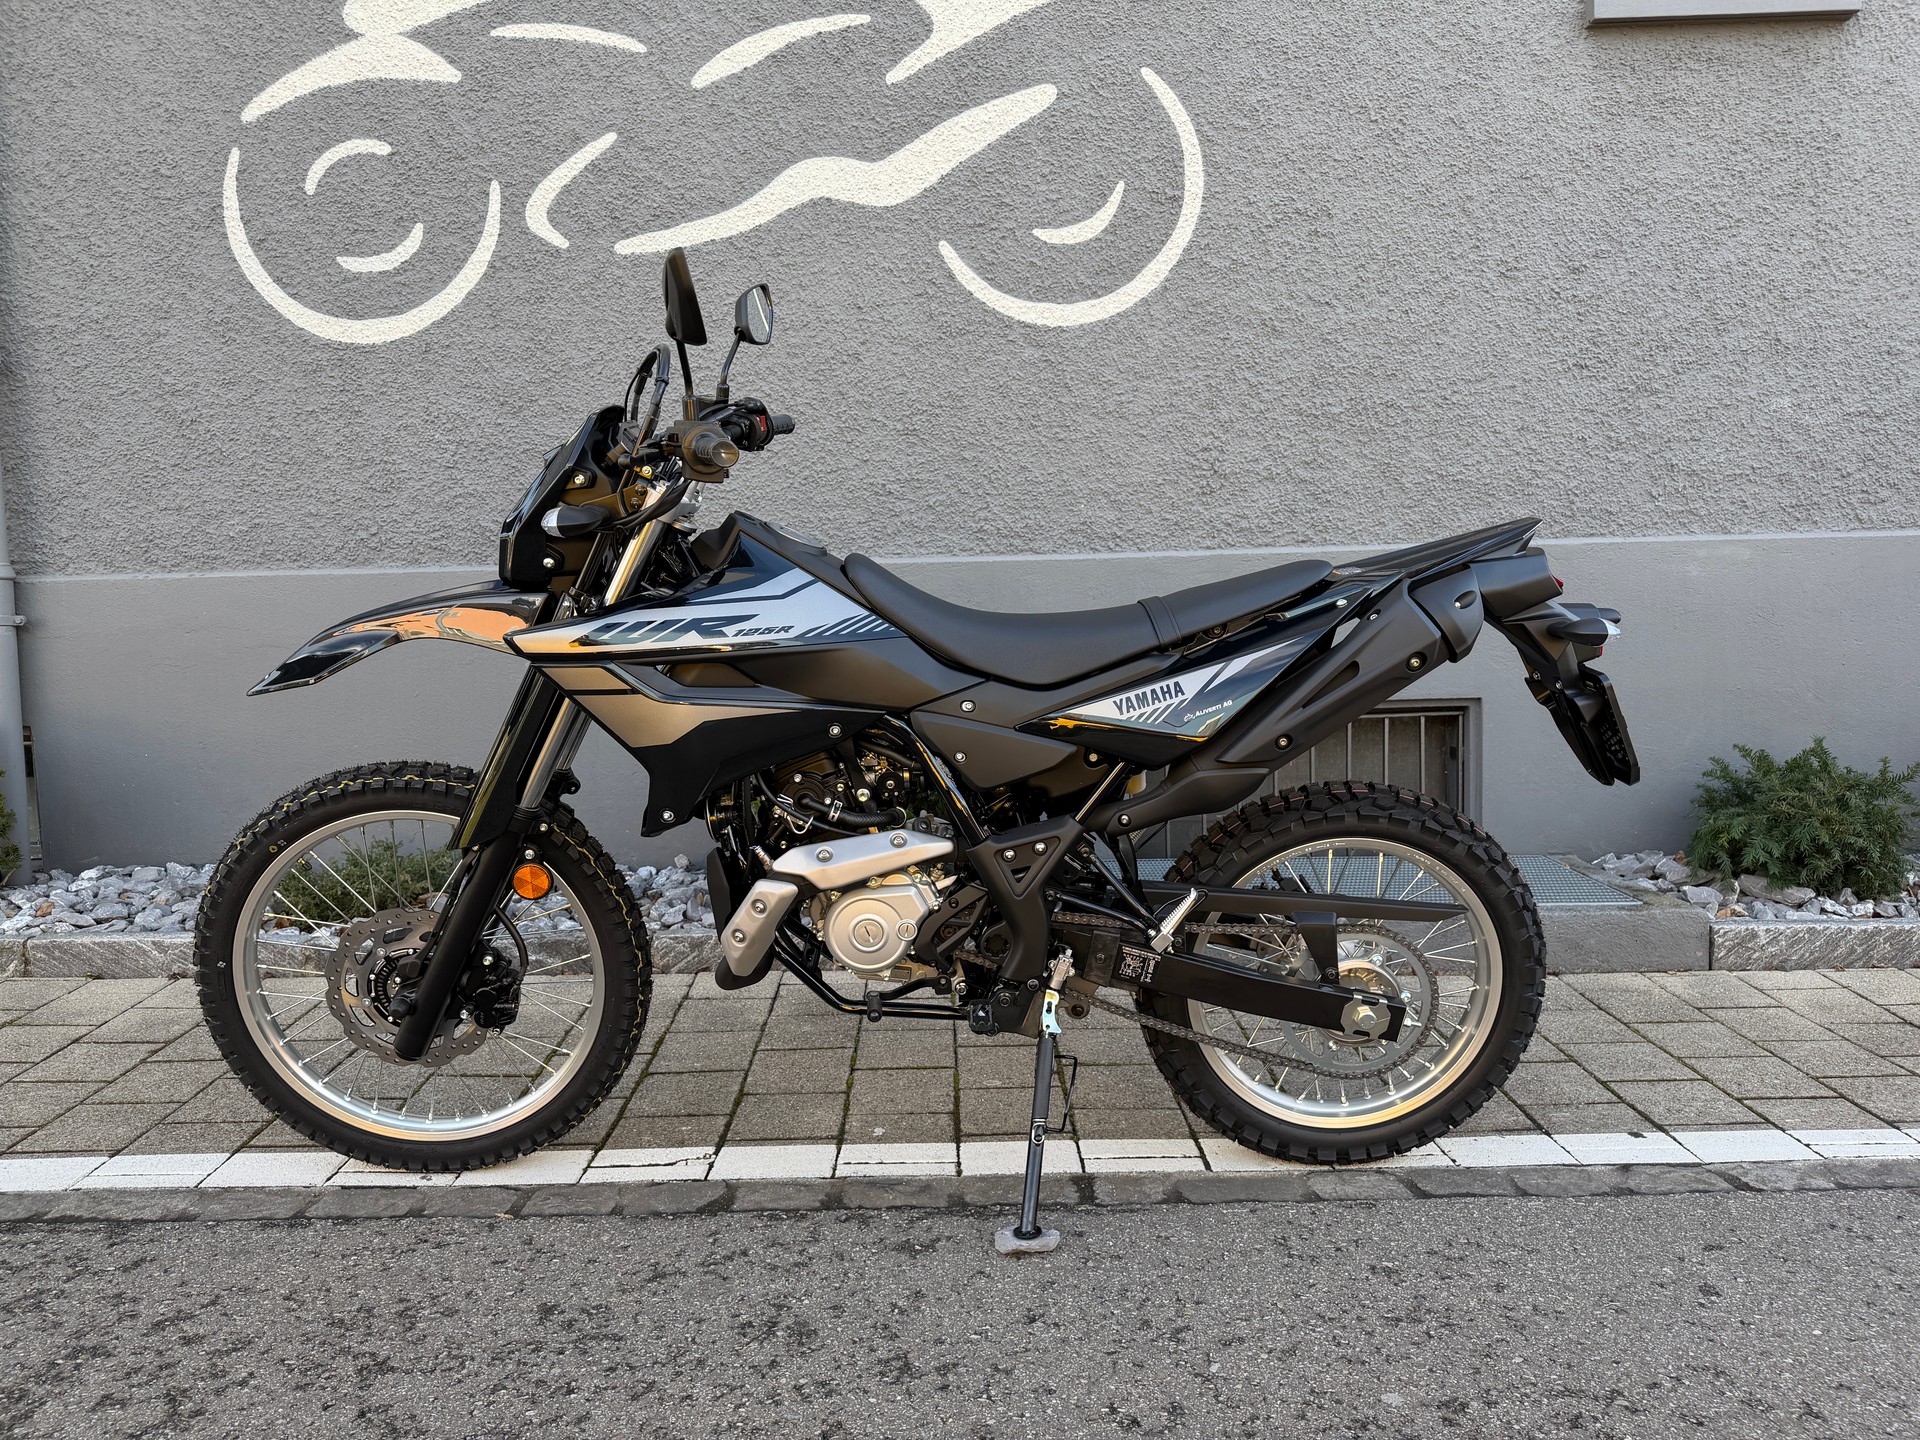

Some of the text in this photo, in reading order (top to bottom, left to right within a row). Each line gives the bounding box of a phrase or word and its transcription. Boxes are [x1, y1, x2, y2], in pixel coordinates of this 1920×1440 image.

[569, 614, 795, 647] WR 125R
[1113, 681, 1186, 715] YAMAHA
[1223, 700, 1233, 708] AG
